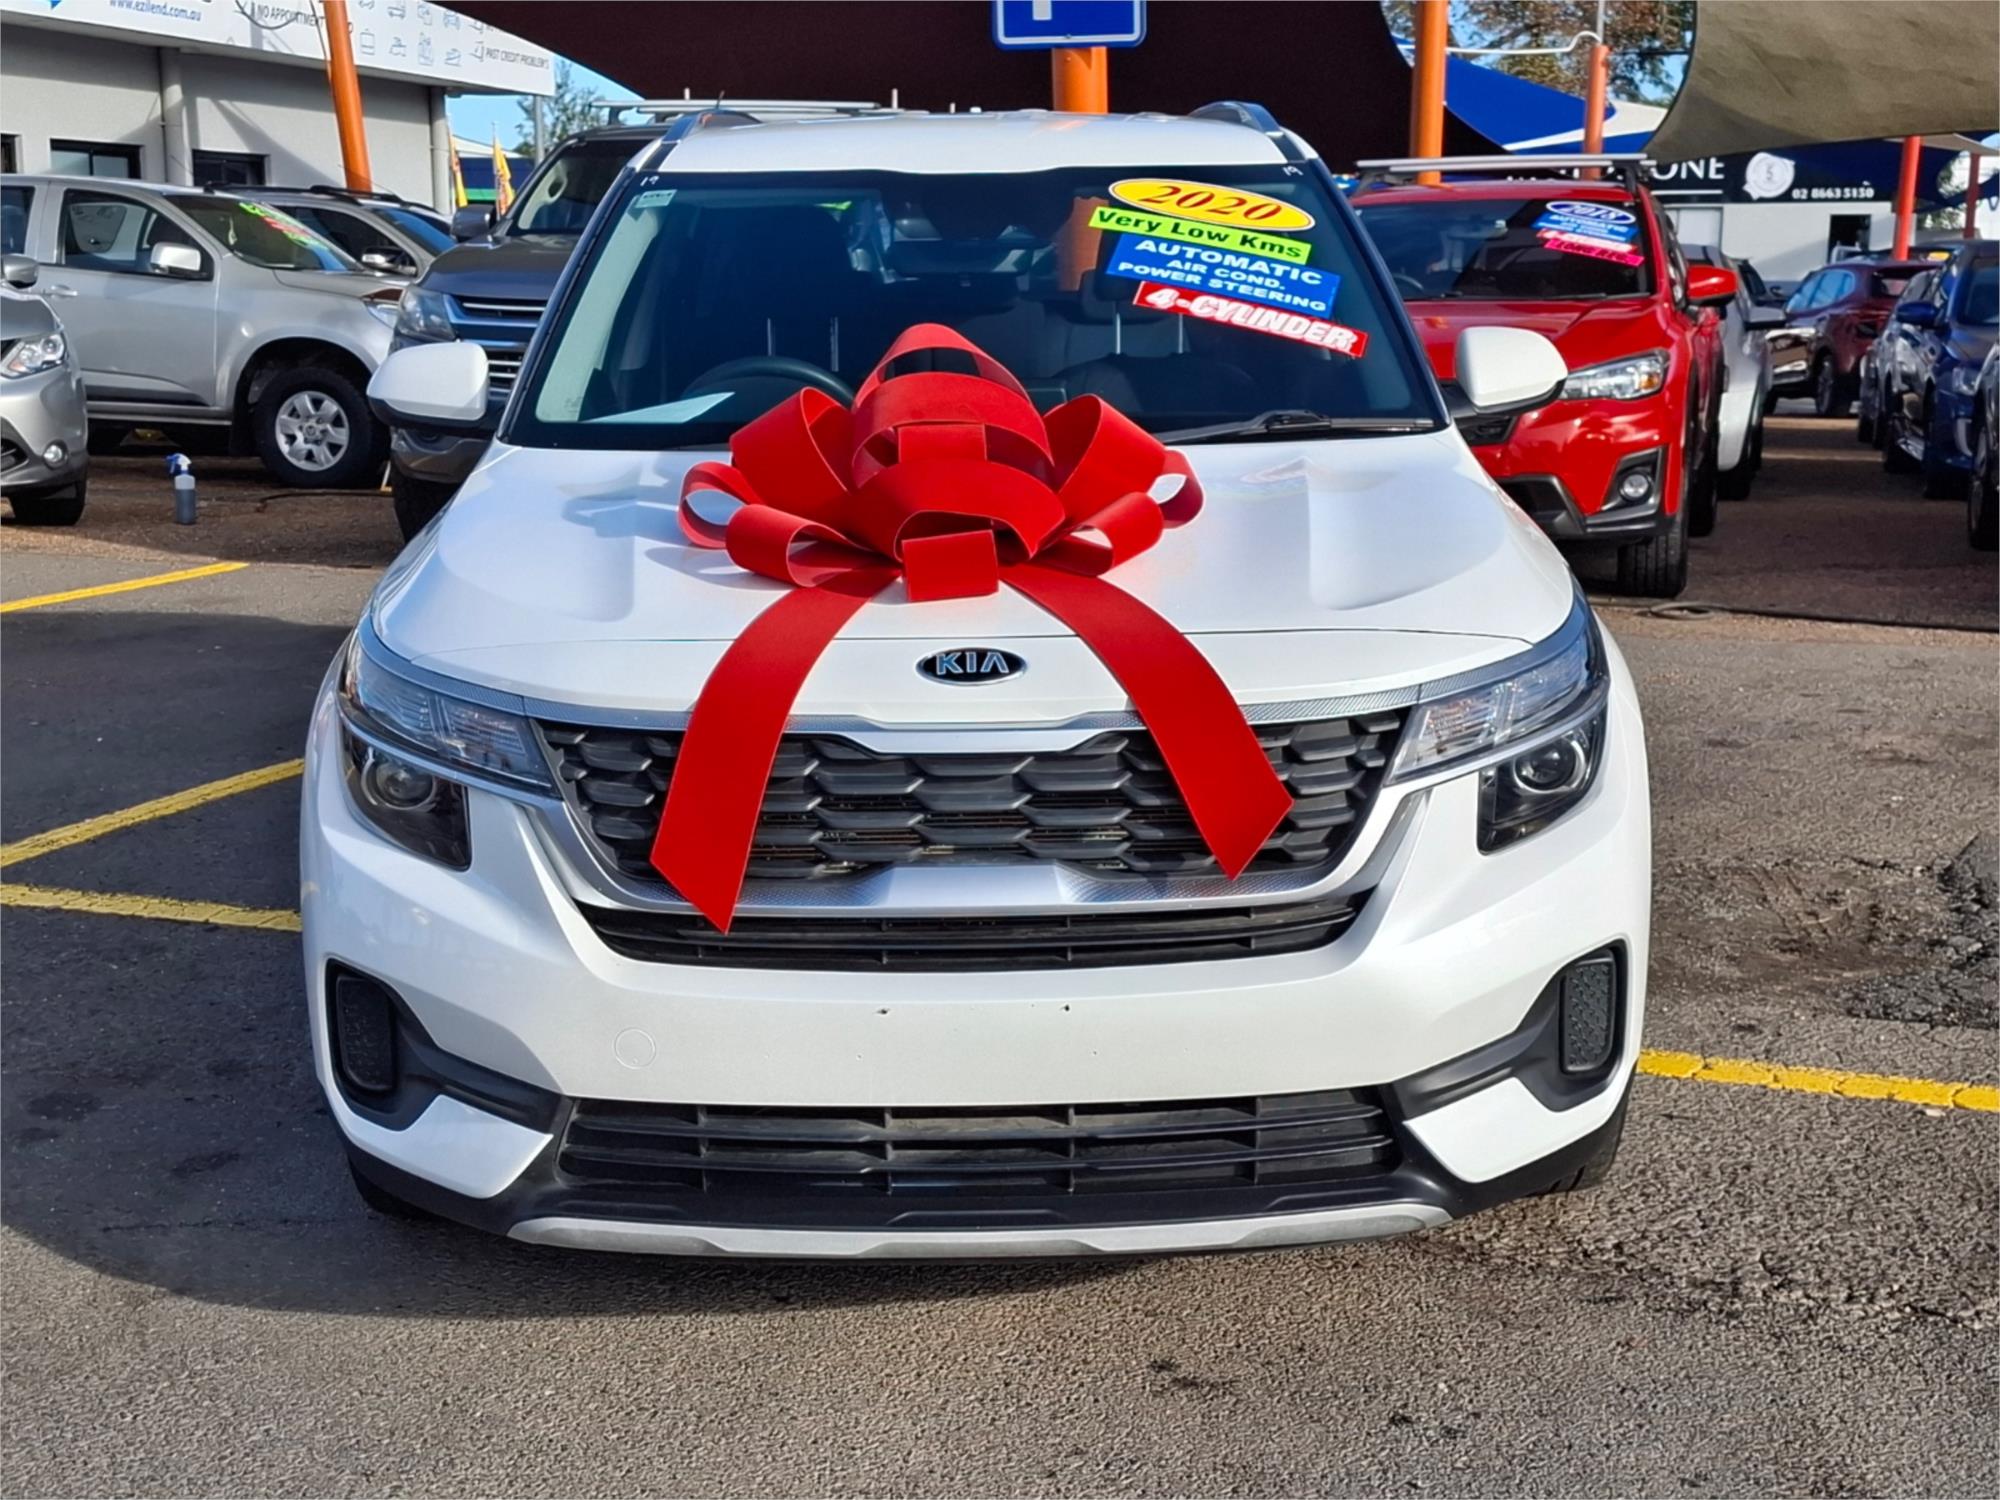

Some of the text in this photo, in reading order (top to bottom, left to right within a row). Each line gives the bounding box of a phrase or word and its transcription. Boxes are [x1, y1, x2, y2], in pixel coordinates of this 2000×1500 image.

[257, 4, 270, 18] NO
[1138, 185, 1282, 221] 2020
[1097, 210, 1303, 259] Very Low Kms
[1135, 239, 1323, 285] AUTOMATIC
[1166, 258, 1286, 291] AIR COND.
[1118, 262, 1327, 312] POWER STEERING
[1144, 287, 1360, 351] 4-CYLINDER
[936, 651, 1009, 676] KIA
